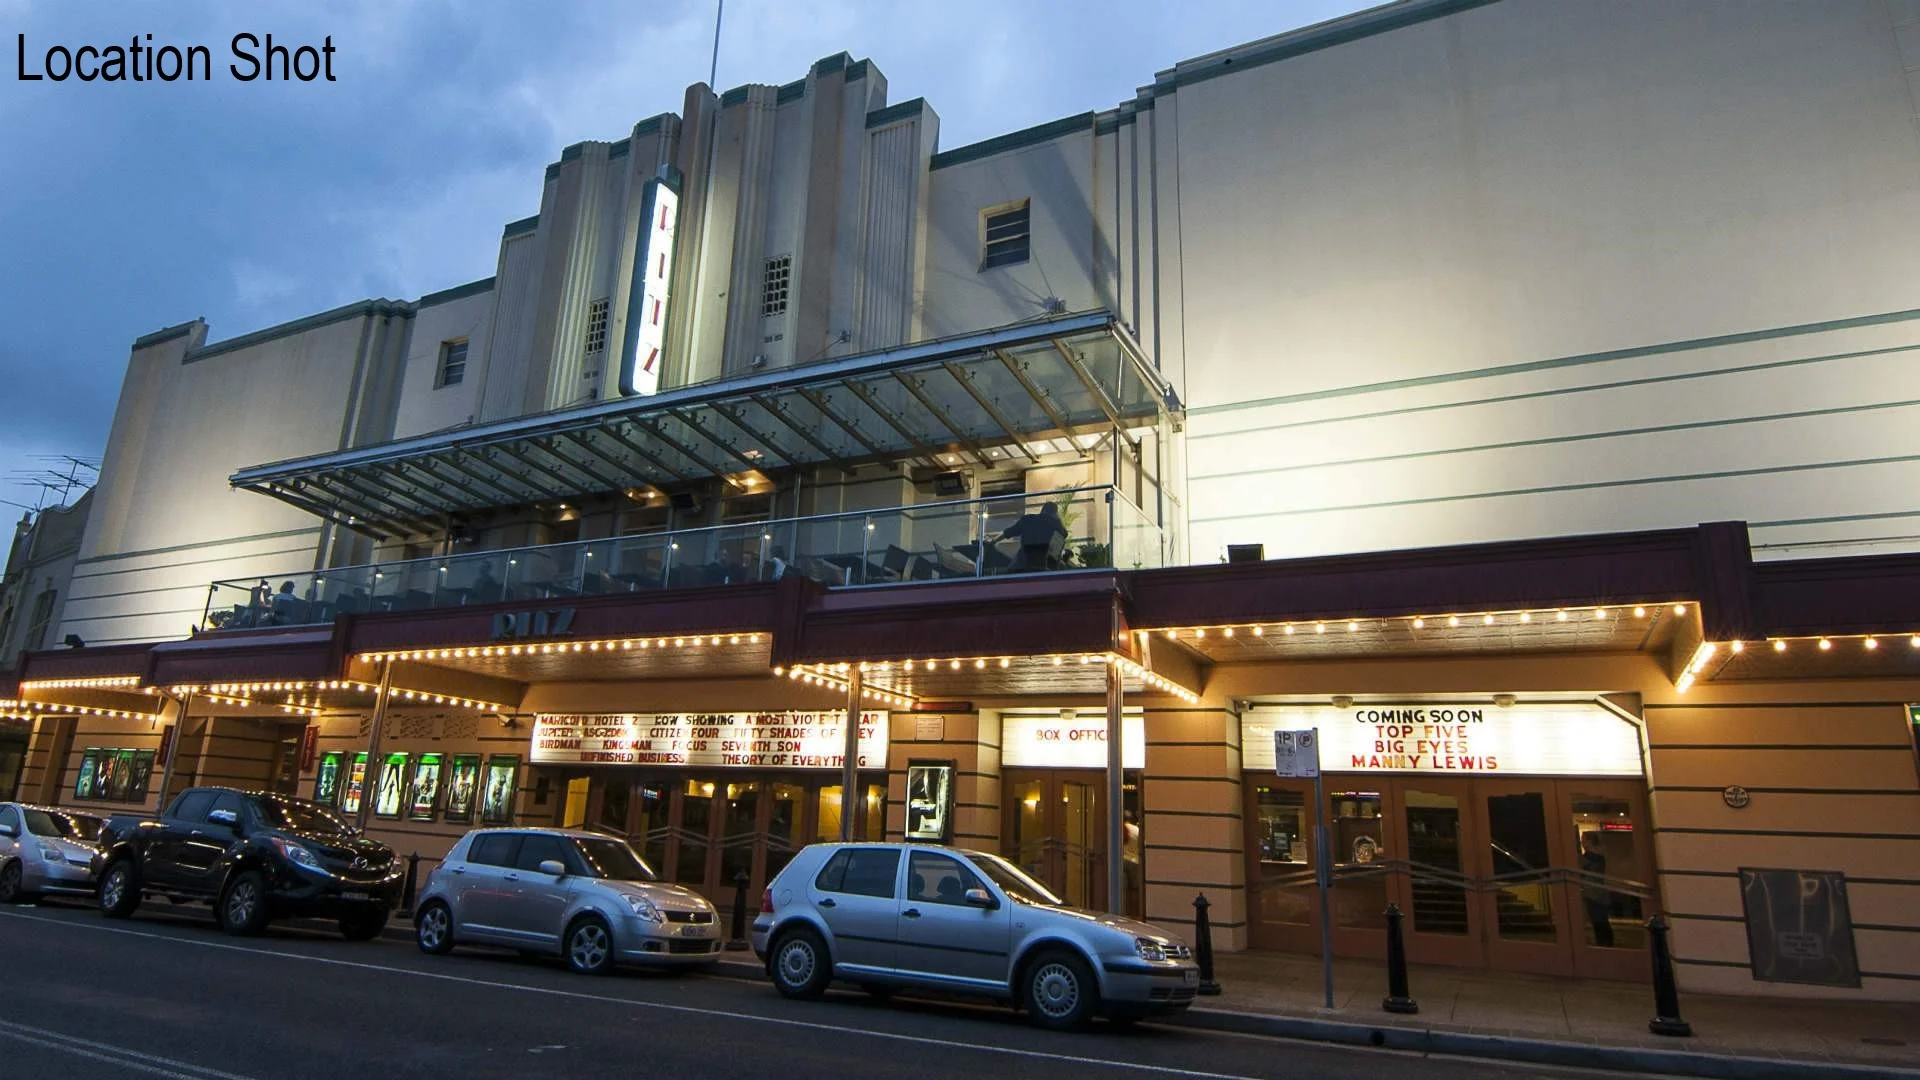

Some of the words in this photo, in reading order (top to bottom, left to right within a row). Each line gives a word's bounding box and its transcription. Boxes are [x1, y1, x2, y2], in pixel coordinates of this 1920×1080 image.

[594, 715, 625, 726] HOTEL
[632, 716, 639, 726] 2
[686, 714, 734, 726] SHOWING
[745, 715, 752, 725] A
[755, 715, 785, 725] MOST
[1356, 709, 1425, 723] COMING
[1430, 709, 1483, 723] SOON
[691, 727, 720, 738] FOUR
[1069, 729, 1108, 741] OFFIC
[1376, 725, 1413, 738] TOP
[1424, 725, 1467, 738] FIVE
[540, 739, 582, 749] BIRDMAN
[777, 741, 801, 752] SON
[1375, 740, 1404, 753] BIG
[1417, 740, 1468, 753] EYES
[722, 753, 766, 765] THEORY
[771, 754, 788, 766] OF
[791, 754, 867, 767] EVERYTHG
[1352, 754, 1421, 769] MANNY
[1433, 756, 1498, 769] LEWIS
